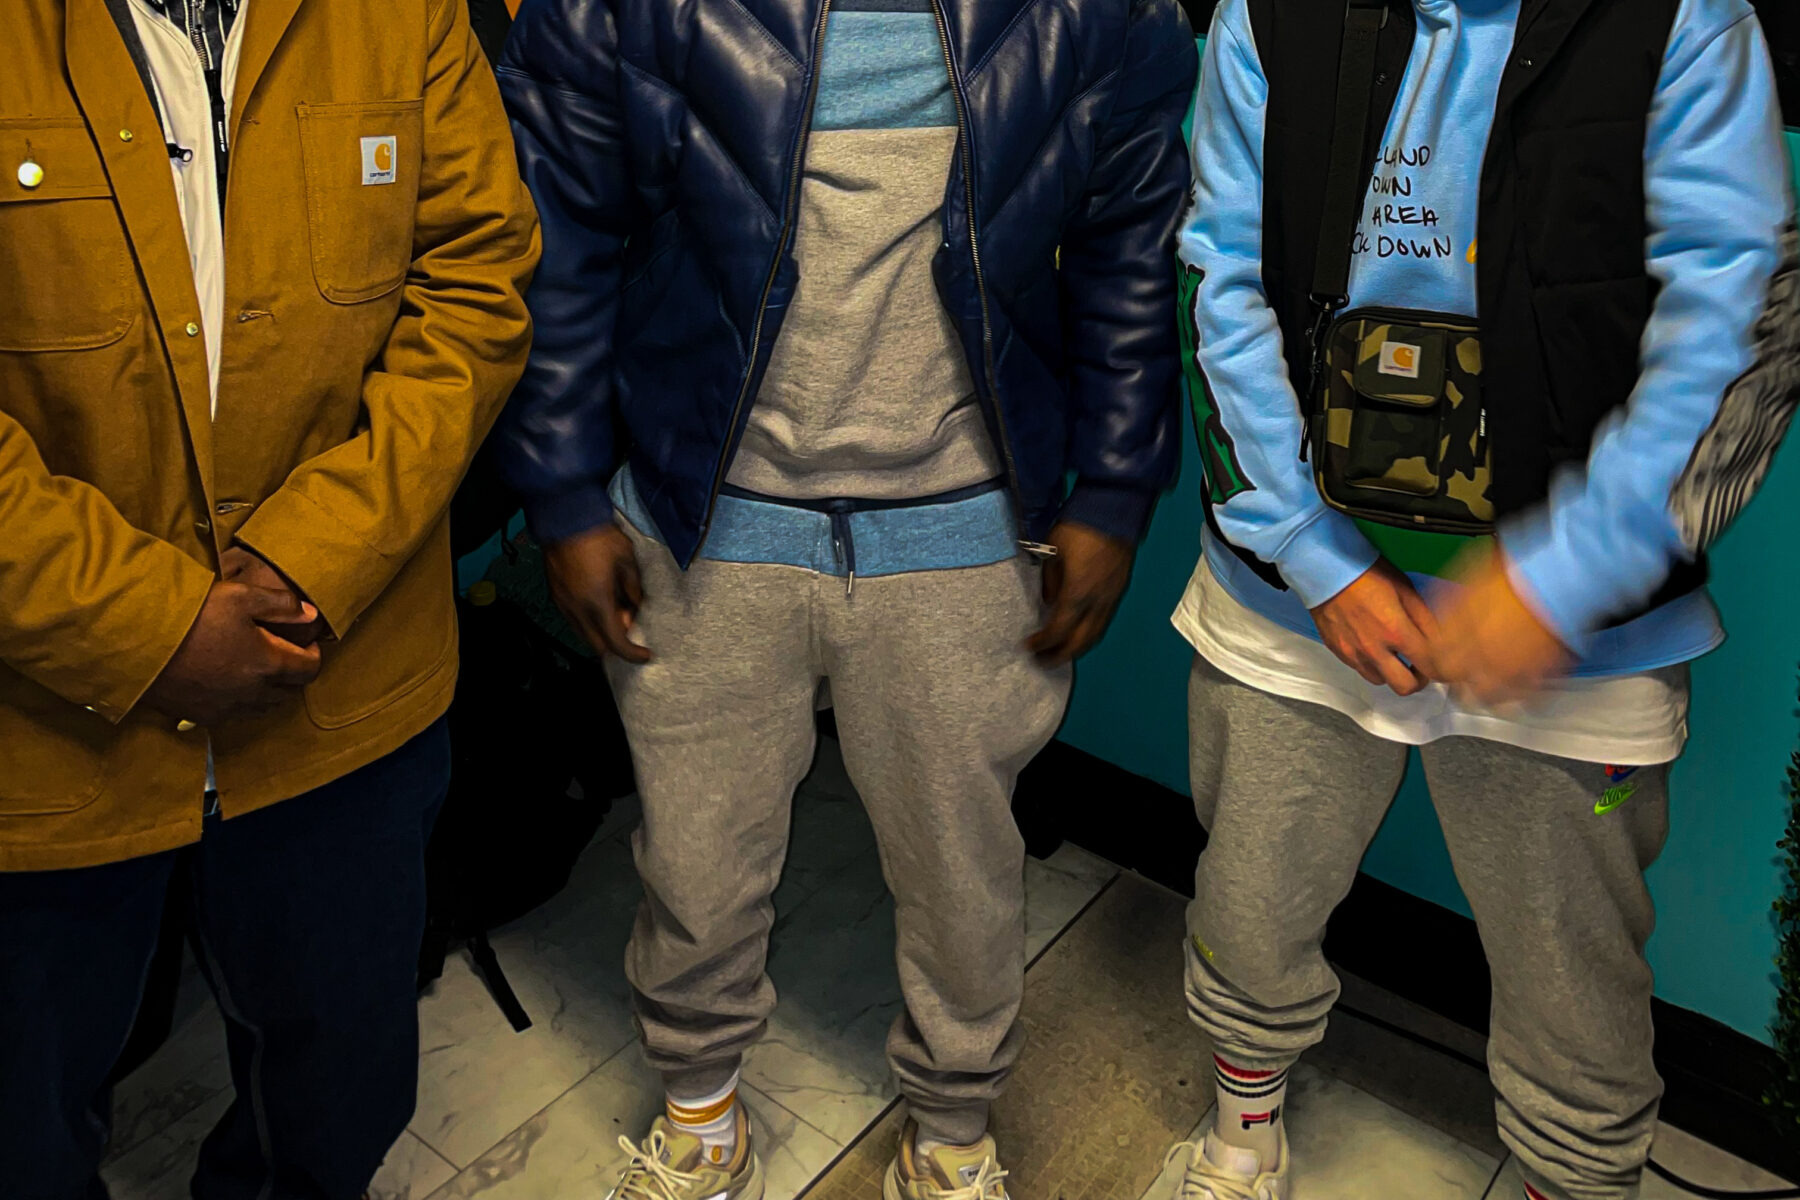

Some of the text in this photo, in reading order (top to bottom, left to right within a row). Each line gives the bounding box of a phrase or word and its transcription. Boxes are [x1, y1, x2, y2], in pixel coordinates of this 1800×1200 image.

[1372, 175, 1411, 197] OWN
[1372, 203, 1439, 228] AREA
[1377, 234, 1452, 259] DOWN
